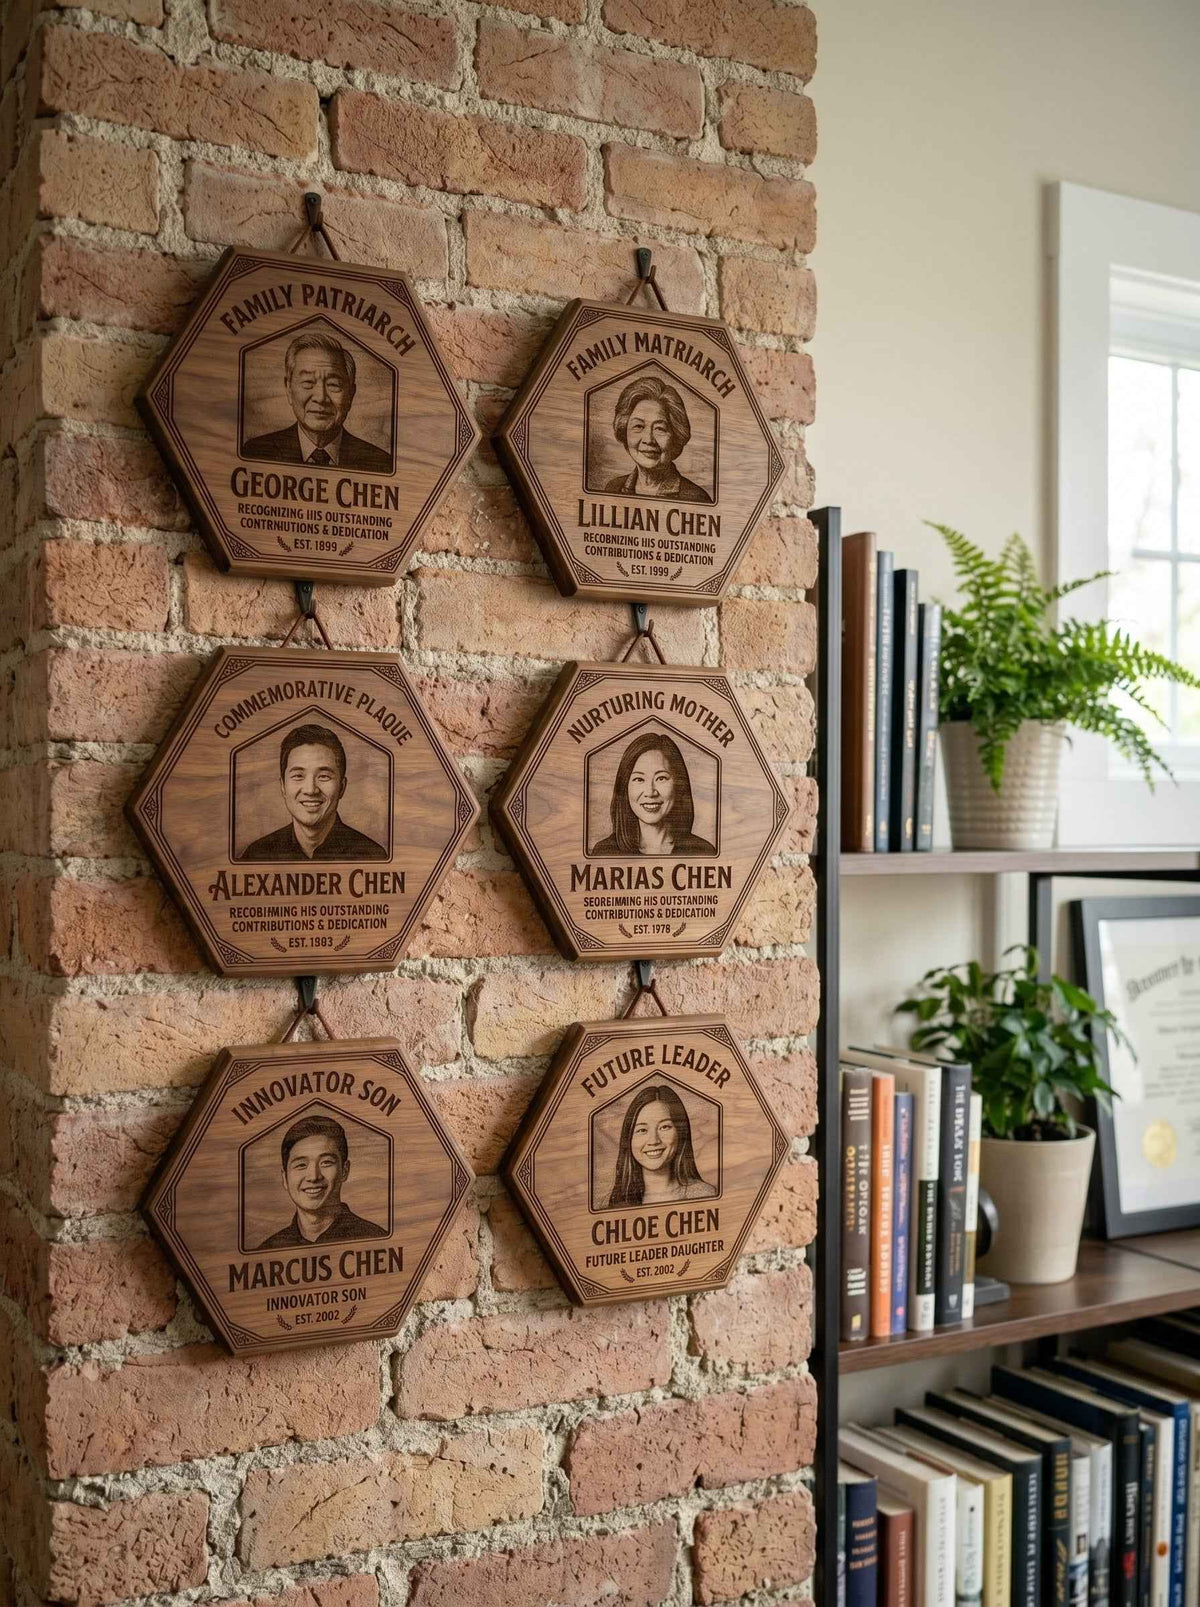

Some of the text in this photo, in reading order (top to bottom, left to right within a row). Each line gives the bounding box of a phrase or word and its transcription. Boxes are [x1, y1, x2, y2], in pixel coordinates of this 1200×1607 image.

[220, 284, 416, 356] FAMILY PATRIARCH
[566, 332, 736, 398] FAMILY MATRIARCH
[231, 467, 399, 511] GEORGE CHEN
[238, 503, 303, 519] RECOGNIZING
[325, 511, 392, 528] OUTSTANDING
[578, 499, 721, 537] LILLIAN CHEN
[322, 525, 328, 535] &
[332, 525, 389, 540] DEDICATION
[294, 539, 337, 551] EST. 1899
[585, 545, 713, 565] CONTRIBUTIONS & DEDICATION
[658, 539, 716, 554] OUTSTANDING
[631, 565, 669, 576] EST. 1999
[214, 680, 412, 746] COMMEMORATIVE PLAQUE
[567, 691, 735, 748] NURTURING MOTHER
[208, 869, 406, 900] ALEXANDER CHEN
[570, 863, 732, 892] MARIAS CHEN
[301, 905, 317, 917] HIS
[320, 904, 389, 916] OUTSTANDING
[644, 896, 657, 906] HIS
[660, 895, 718, 905] OUTSTANDING
[232, 918, 387, 932] CONTRIBUTIONS & DEDICATION
[586, 908, 715, 920] CONTRIBUTIONS & DEDICATION
[634, 924, 670, 934] EST. 1978
[289, 938, 308, 947] EST.
[581, 1044, 731, 1098] FUTURE LEADER
[231, 1071, 401, 1125] INNOVATOR SON
[592, 1208, 719, 1245] CHLOE CHEN
[586, 1240, 724, 1268] FUTURE LEADER DAUGHTER
[229, 1247, 403, 1292] MARCUS CHEN
[637, 1265, 674, 1278] EST. 2002
[267, 1288, 366, 1311] INNOVATOR SON
[296, 1310, 340, 1325] EST. 2002
